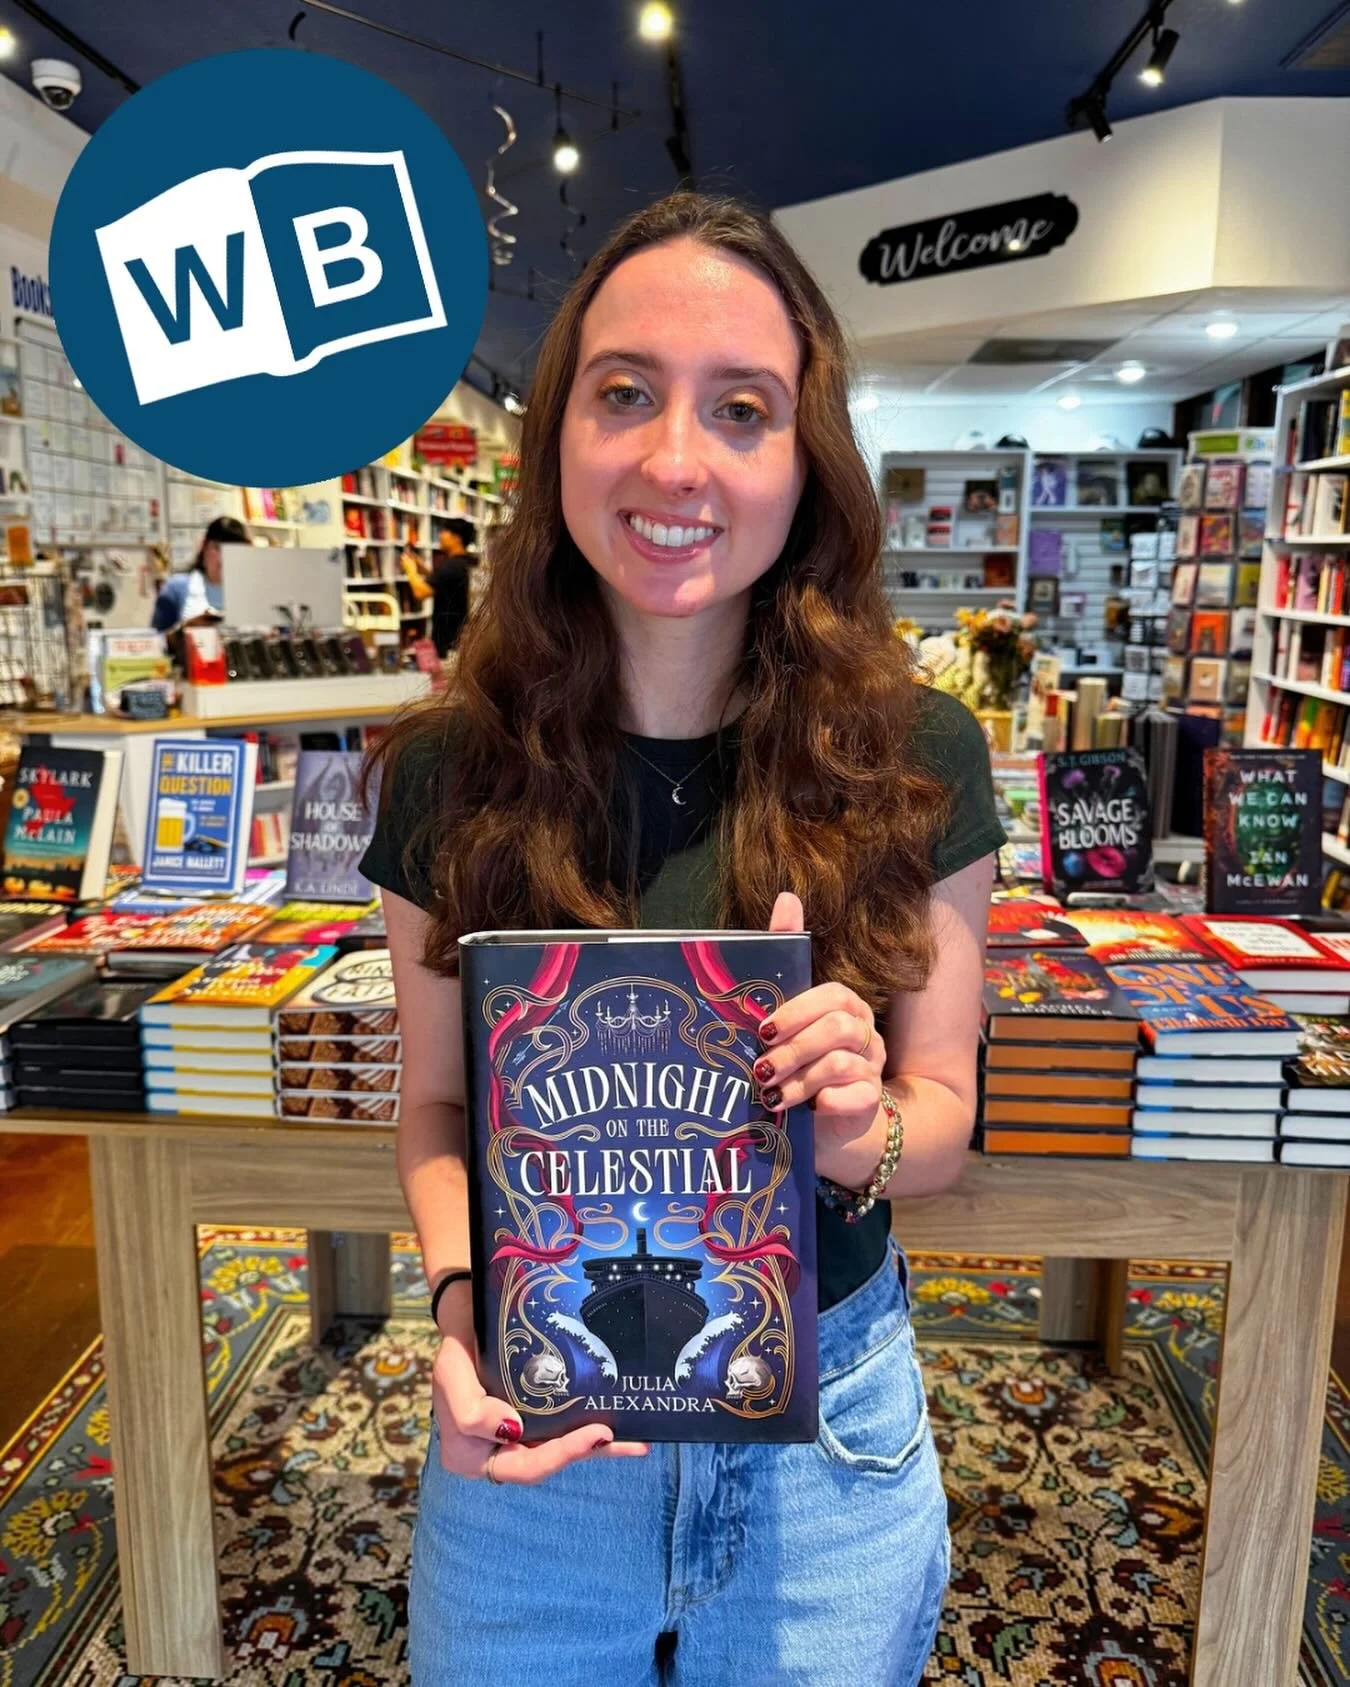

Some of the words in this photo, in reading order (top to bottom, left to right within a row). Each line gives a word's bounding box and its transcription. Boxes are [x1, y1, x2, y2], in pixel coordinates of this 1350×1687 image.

[880, 218, 1054, 278] Welcome
[177, 752, 233, 774] KILLER
[160, 776, 232, 795] QUESTION
[1240, 770, 1297, 784] WHAT
[1229, 793, 1258, 806] WE
[1267, 792, 1308, 805] CAN
[304, 802, 363, 822] HOUSE
[1058, 798, 1134, 826] SAVAGE
[1238, 814, 1299, 828] KNOW
[1059, 824, 1138, 850] BLOOMS
[1250, 851, 1288, 865] IAN
[1226, 872, 1309, 888] McEWAN
[523, 1061, 750, 1129] MIDNIGHT
[605, 1119, 629, 1138] ON
[635, 1119, 670, 1137] THE
[519, 1147, 753, 1197] CELESTIAL
[621, 1375, 677, 1393] JULIA
[584, 1395, 717, 1413] ALEXANDRA
